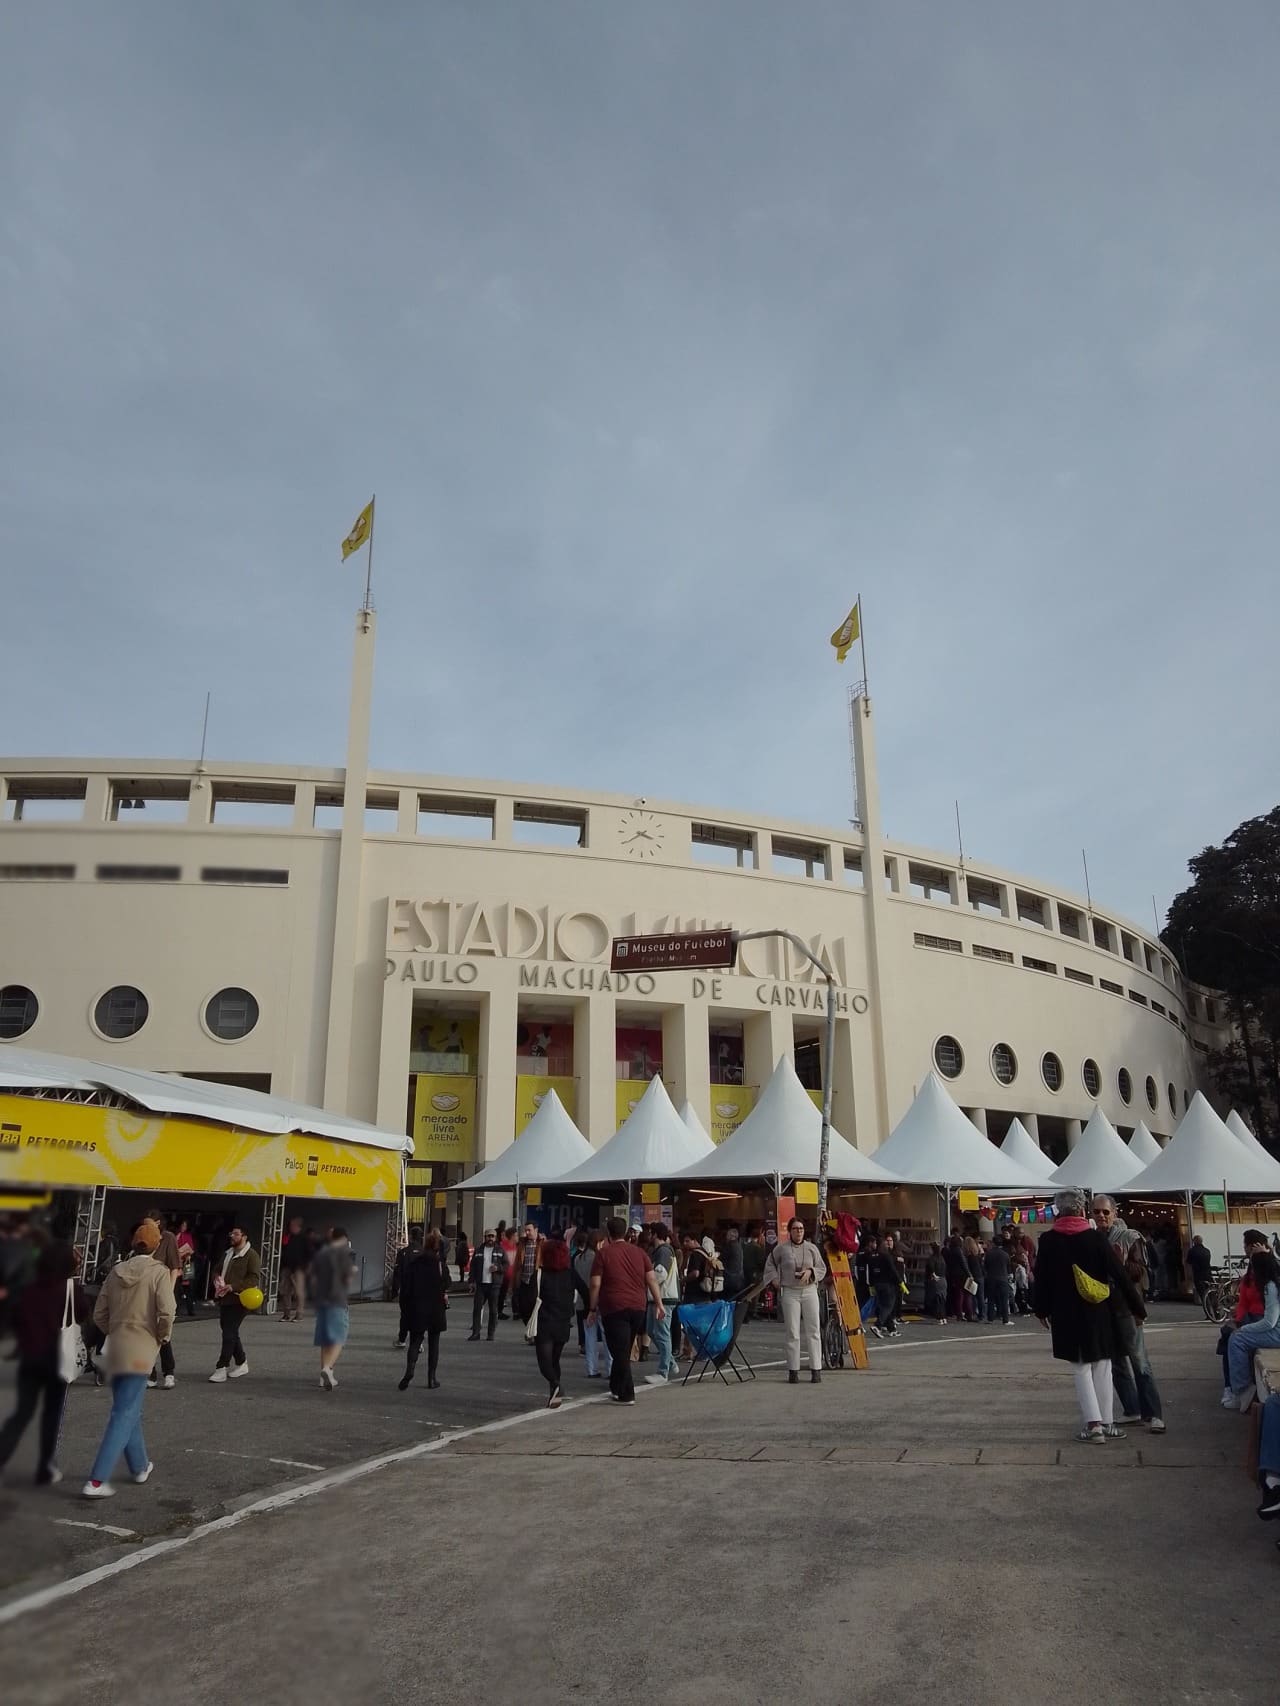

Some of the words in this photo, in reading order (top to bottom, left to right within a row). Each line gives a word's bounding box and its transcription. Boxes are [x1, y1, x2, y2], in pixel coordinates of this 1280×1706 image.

[385, 896, 612, 964] ESTADIO
[632, 943, 666, 953] Museu
[668, 941, 681, 951] do
[383, 958, 478, 984] PAULO
[519, 964, 656, 995] MACHADO
[692, 976, 722, 1000] DE
[756, 983, 869, 1014] CARVAHO
[421, 1115, 468, 1124] mercado
[433, 1123, 455, 1132] livre
[428, 1133, 460, 1141] ARENA
[285, 1157, 304, 1170] Palco
[320, 1163, 357, 1175] PETROBRAS
